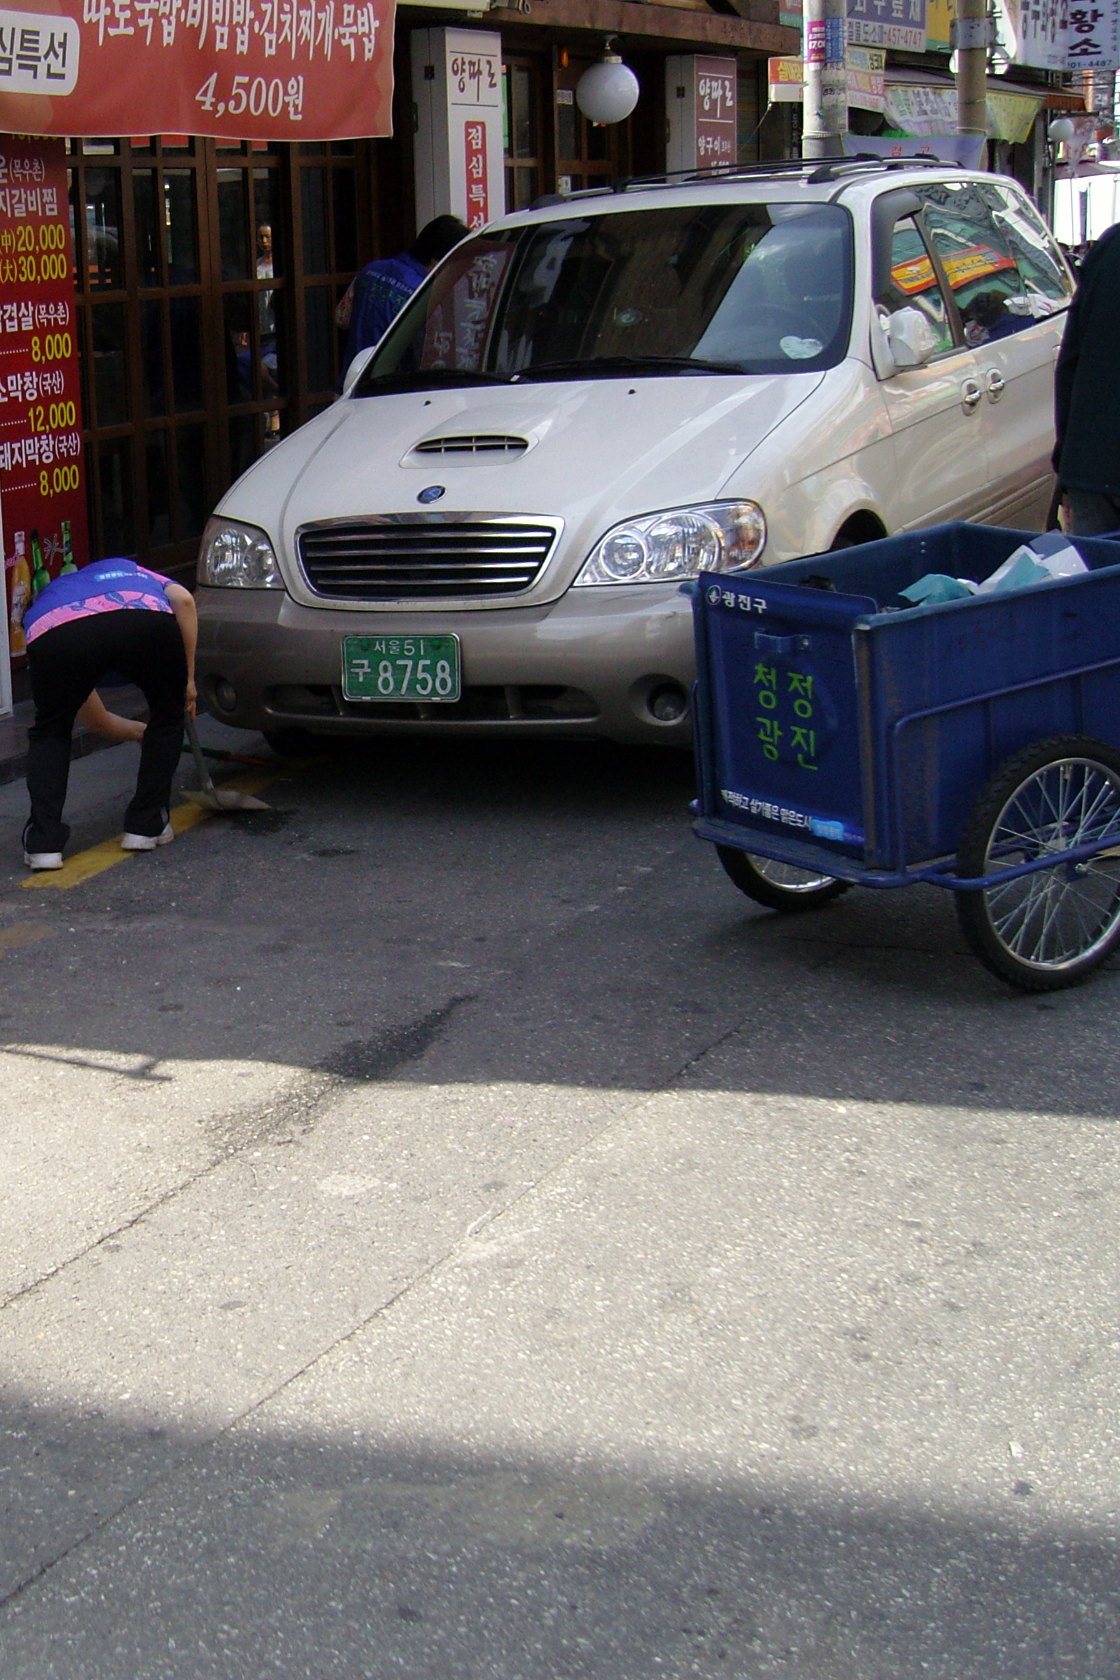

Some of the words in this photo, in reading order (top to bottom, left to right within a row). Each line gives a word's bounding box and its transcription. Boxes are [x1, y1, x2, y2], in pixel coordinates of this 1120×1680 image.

[195, 72, 304, 121] 4,500원
[31, 332, 72, 364] 8,000
[28, 401, 76, 433] 12,000
[40, 464, 80, 497] 8,000
[721, 590, 768, 614] 광진구
